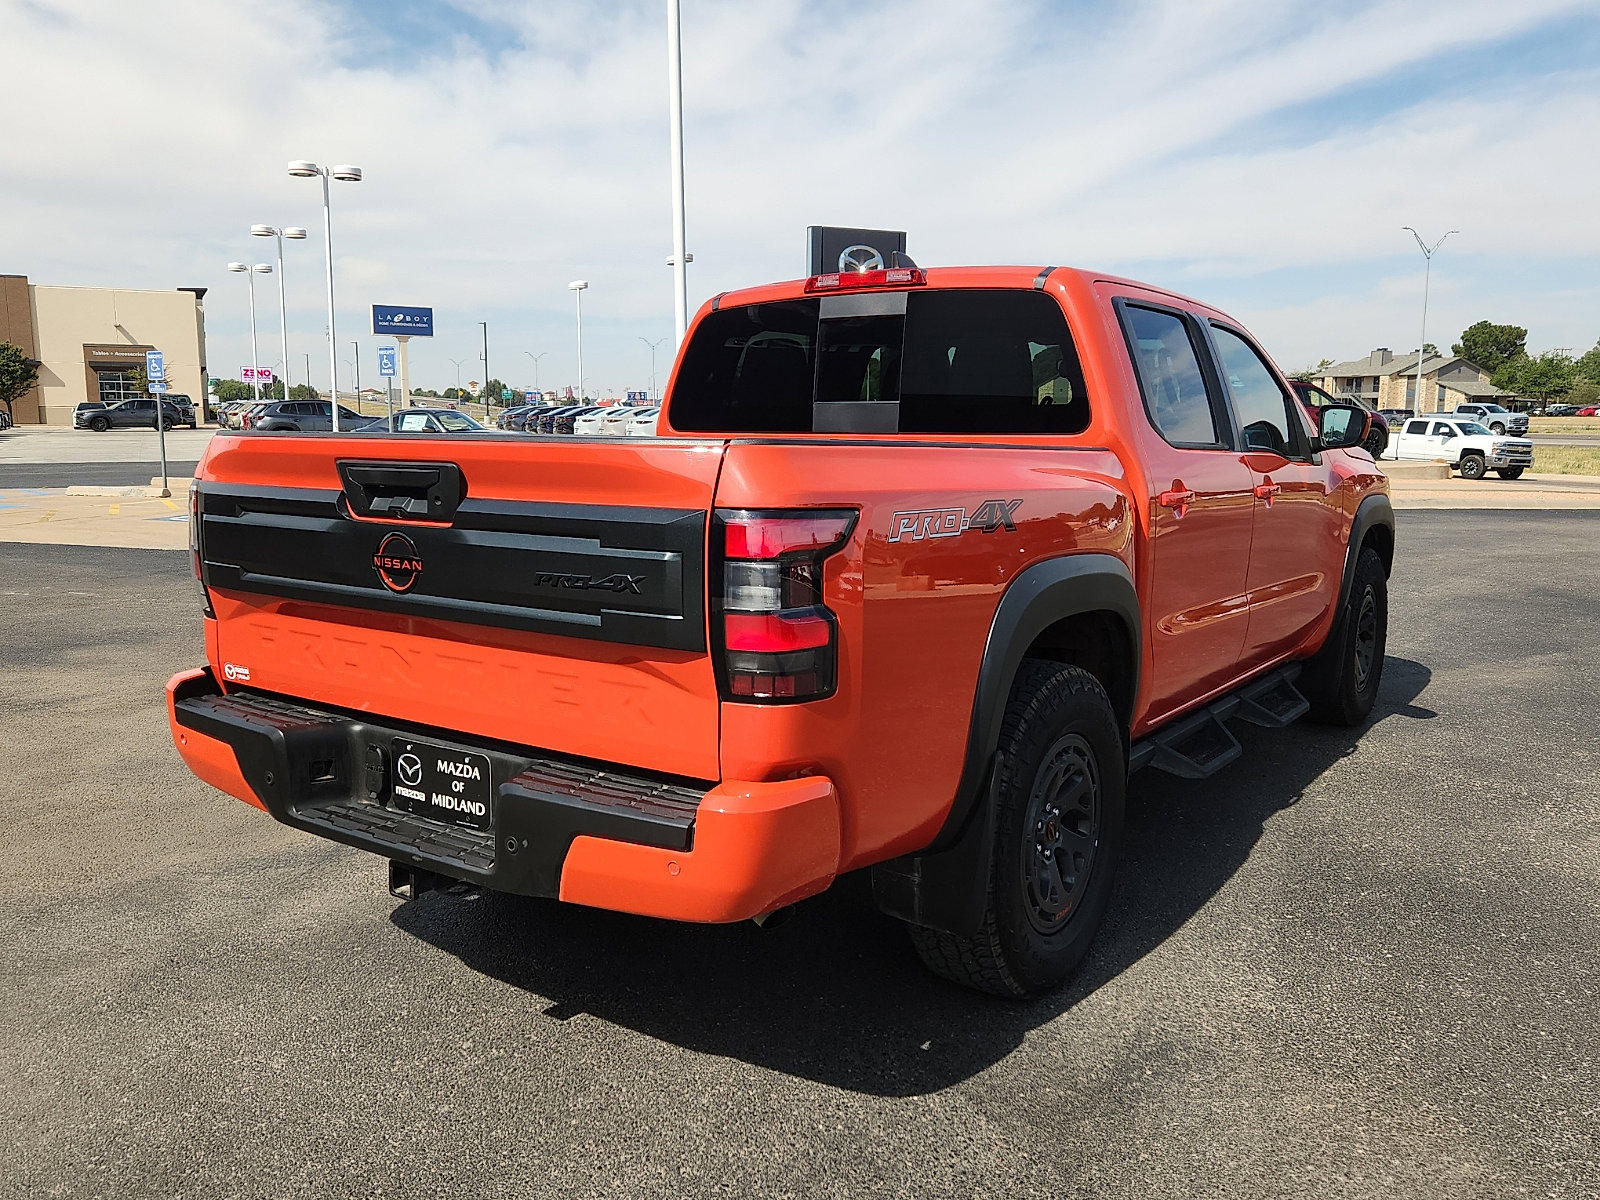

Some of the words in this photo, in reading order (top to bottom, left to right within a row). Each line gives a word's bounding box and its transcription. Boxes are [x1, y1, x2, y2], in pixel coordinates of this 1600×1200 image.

[243, 369, 271, 377] ZENO
[887, 499, 1024, 543] PRO-4X
[373, 556, 422, 571] NISSAN
[534, 571, 647, 595] PRO-4X
[248, 622, 660, 728] FRONTIER
[437, 759, 480, 781] MAZDA
[395, 785, 426, 802] mazda
[451, 780, 465, 793] OF
[431, 792, 486, 816] MIDLAND
